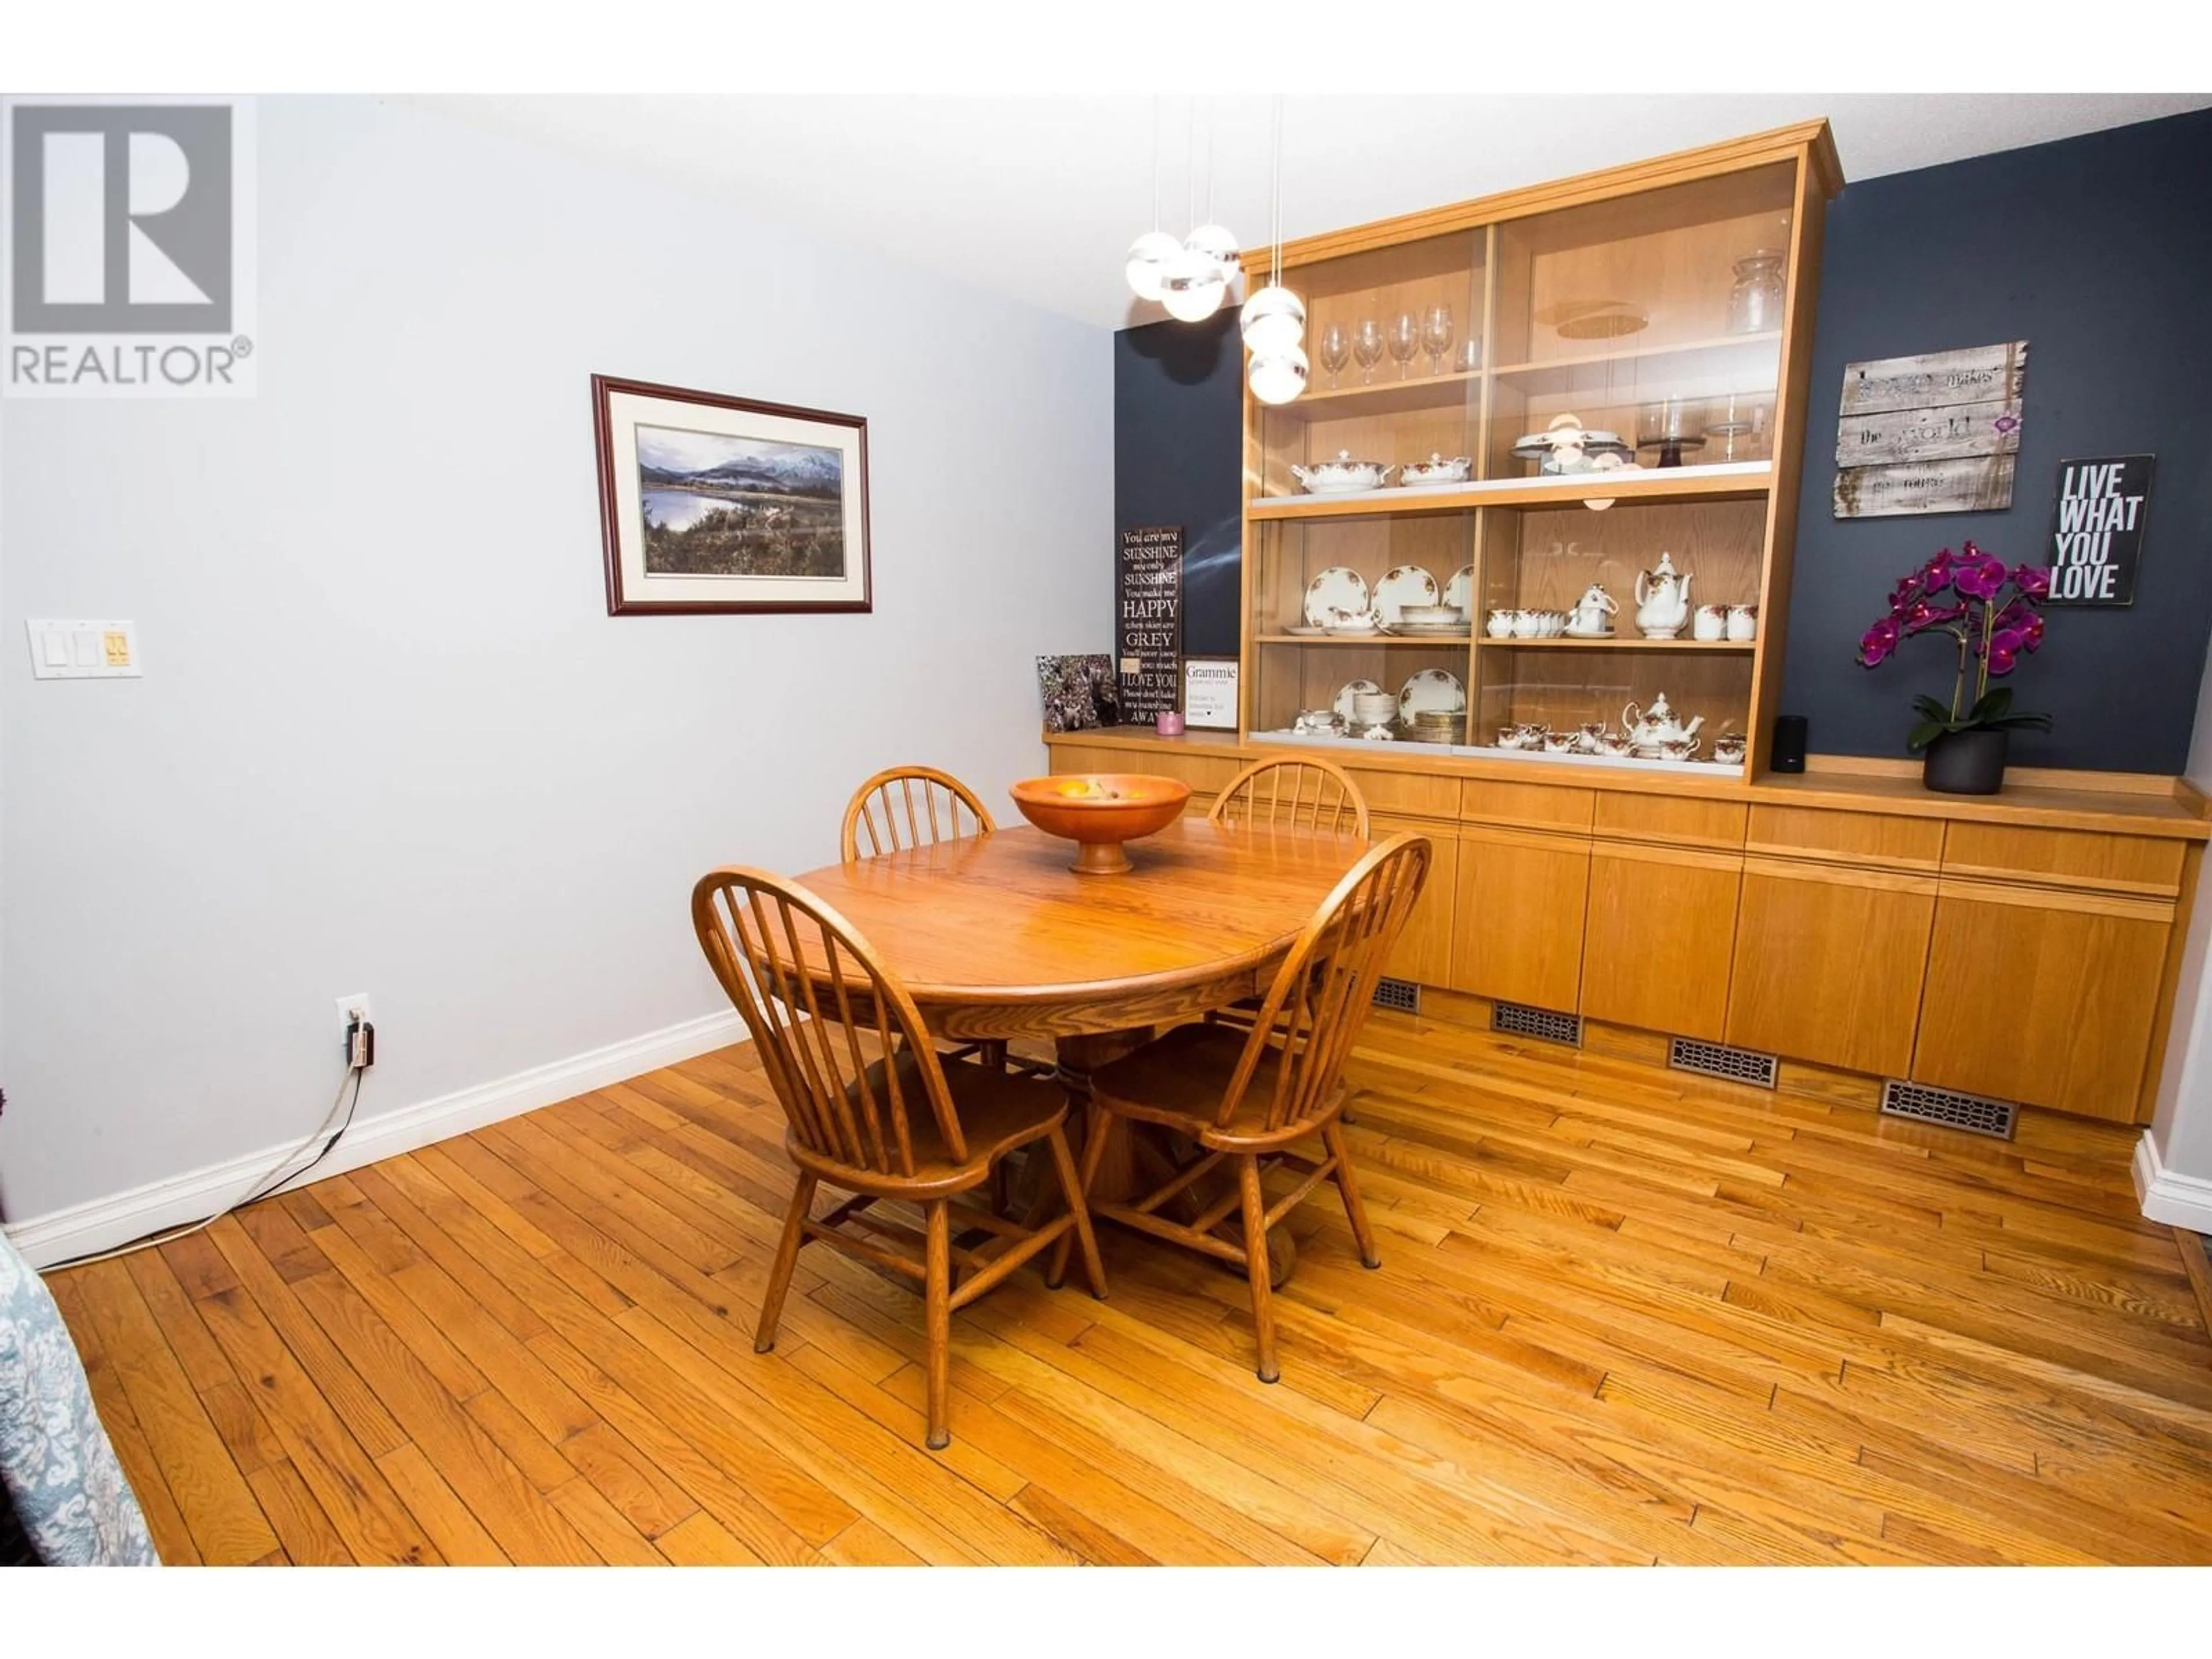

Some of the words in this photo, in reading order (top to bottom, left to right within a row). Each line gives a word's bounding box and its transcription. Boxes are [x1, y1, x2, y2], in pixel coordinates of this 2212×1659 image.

[2063, 463, 2126, 500] LIVE
[2060, 496, 2144, 532] WHAT
[1123, 532, 1141, 543] You
[1143, 533, 1159, 543] are
[1161, 532, 1177, 541] my
[1123, 546, 1177, 561] SUNSHINE
[2055, 531, 2112, 566] YOU
[1124, 572, 1176, 586] SUNSHINE
[2048, 565, 2119, 599] LOVE
[1125, 588, 1141, 598] You
[1123, 599, 1178, 618] HAPPY
[1126, 632, 1173, 646] GREY
[1186, 665, 1236, 679] Grammie
[1127, 673, 1153, 687] LOVE
[1156, 673, 1176, 687] YOU
